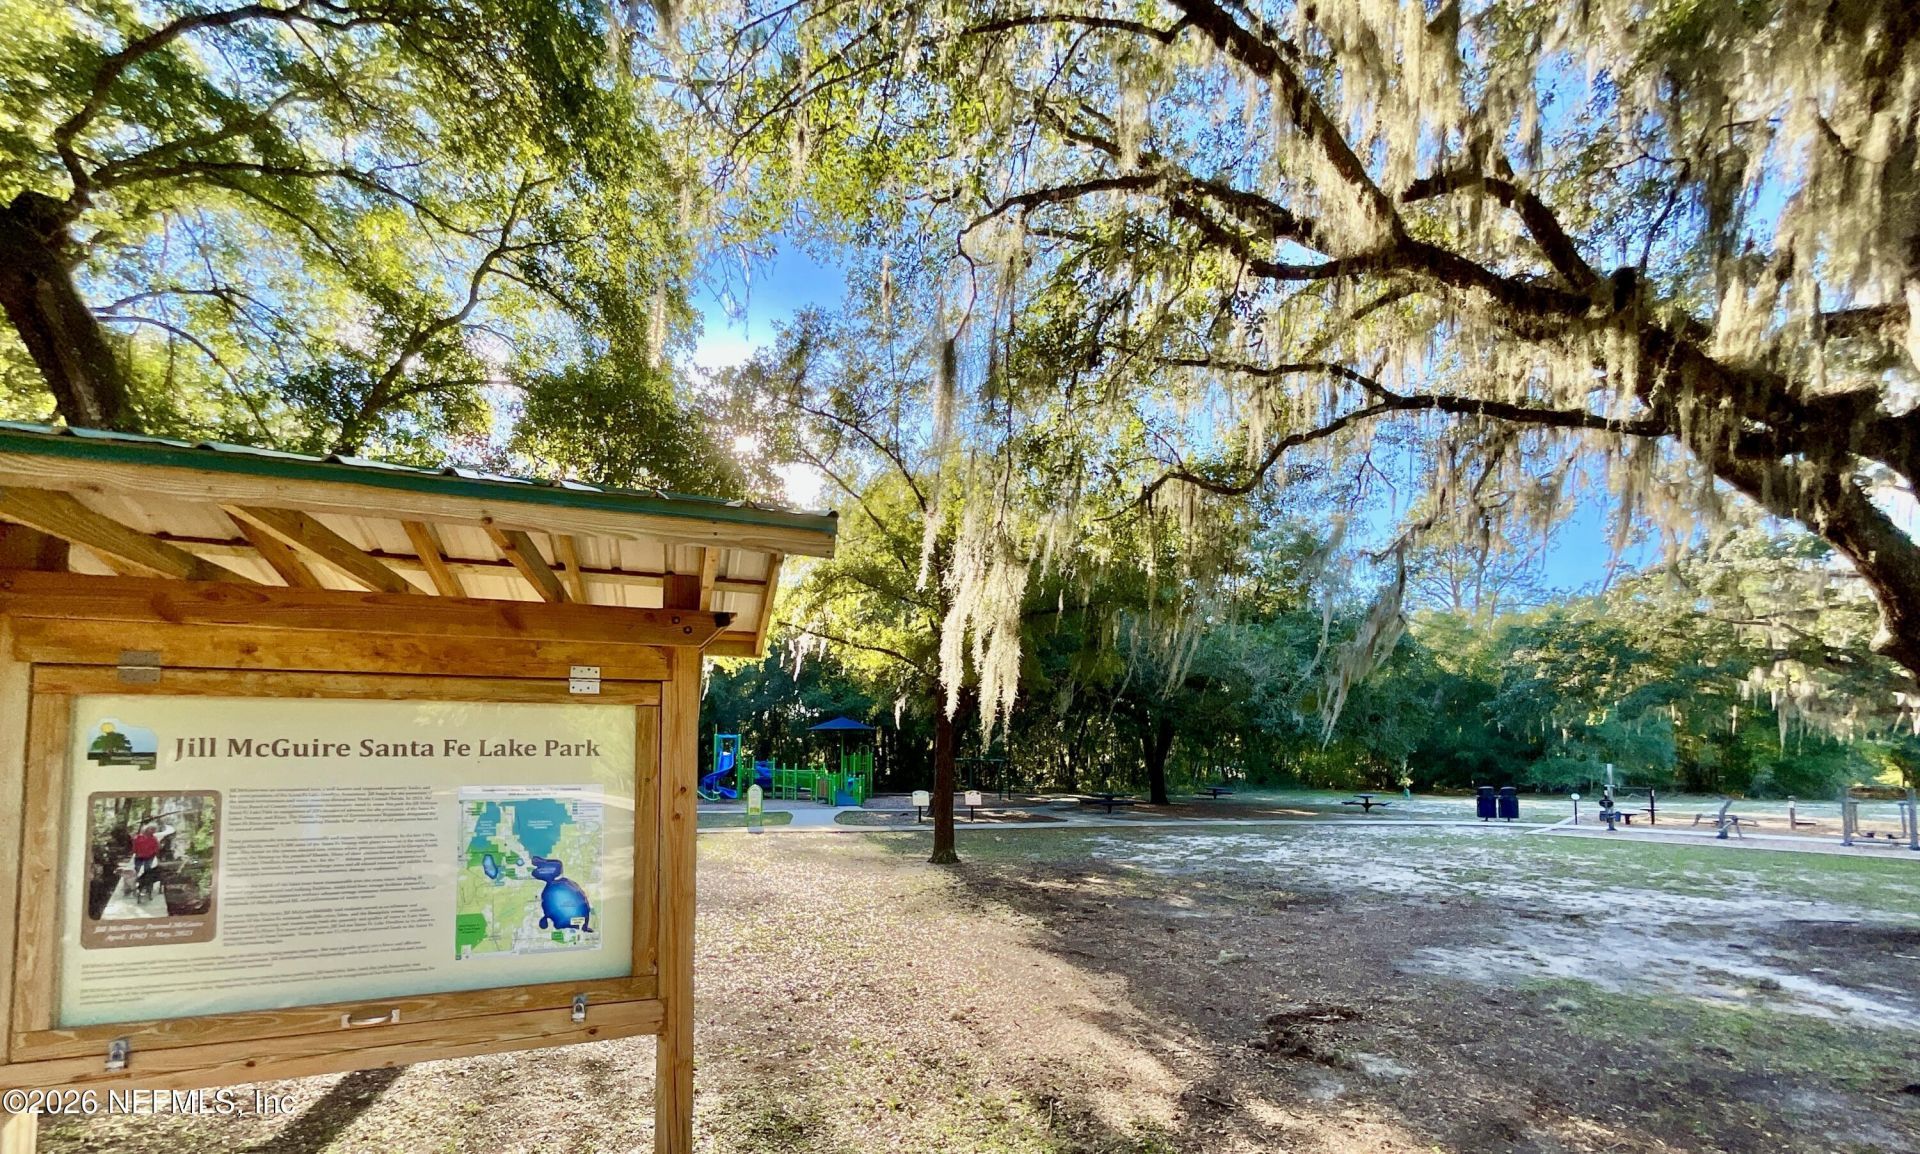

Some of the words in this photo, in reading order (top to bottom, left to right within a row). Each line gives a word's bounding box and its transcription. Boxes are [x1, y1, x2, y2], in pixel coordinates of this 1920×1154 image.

[174, 738, 215, 761] Jill
[227, 738, 351, 758] McGuire
[360, 738, 434, 758] Santa
[443, 739, 471, 758] Fe
[480, 738, 537, 757] Lake
[545, 739, 600, 757] Park
